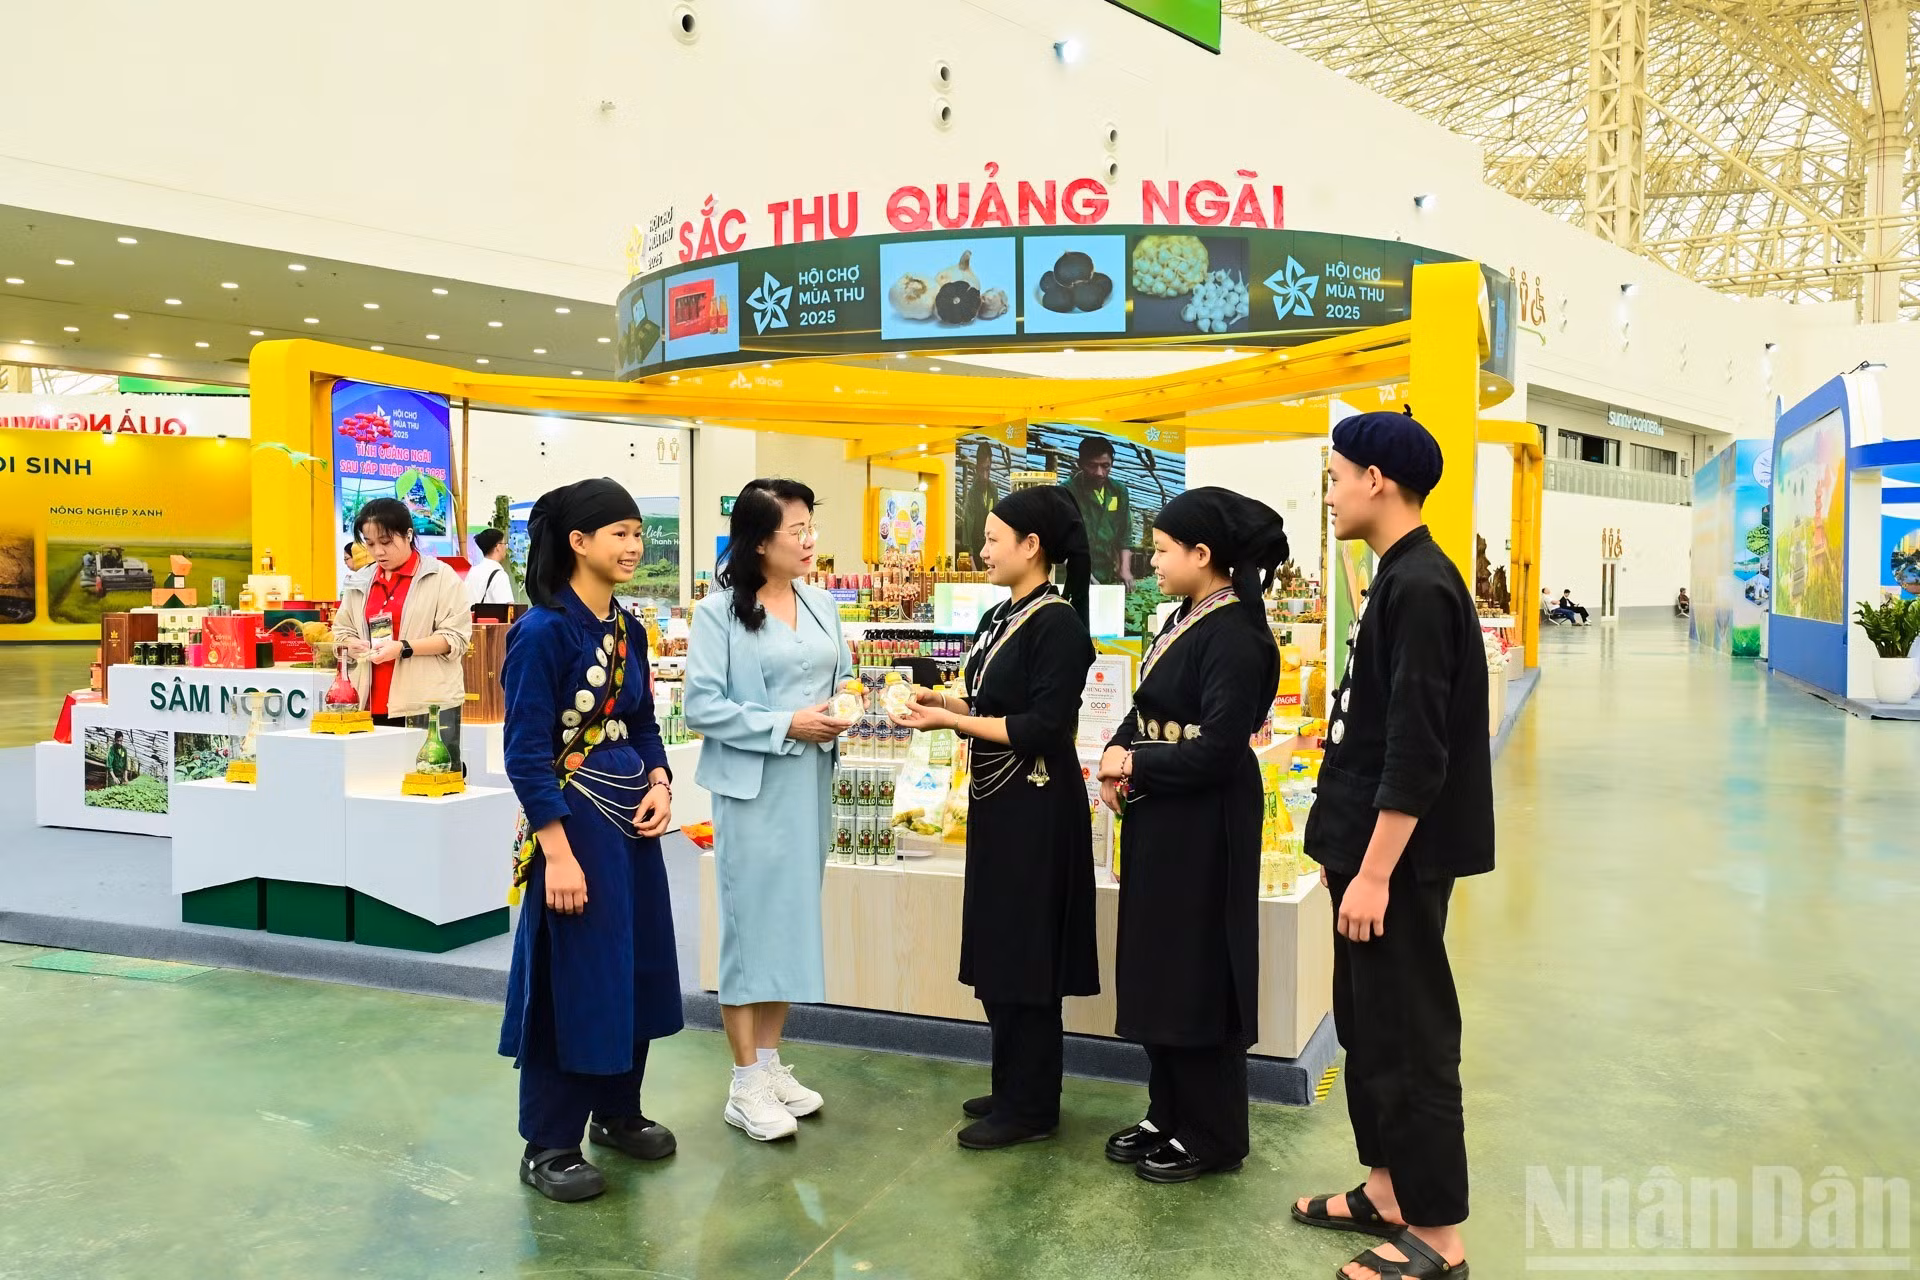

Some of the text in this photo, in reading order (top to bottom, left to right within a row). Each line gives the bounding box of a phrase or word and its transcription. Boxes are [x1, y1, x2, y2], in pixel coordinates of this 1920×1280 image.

[678, 162, 1284, 263] SẮC THU QUẢNG NGÃI
[798, 264, 860, 286] HỘI CHỢ
[1325, 260, 1382, 282] HỘI CHỢ
[798, 286, 865, 306] MÙA THU
[1325, 281, 1385, 302] MÙA THU
[799, 309, 836, 326] 2025
[1325, 304, 1361, 320] 2025
[393, 409, 404, 418] HỘI
[393, 430, 409, 439] 2025
[407, 422, 420, 430] THU
[410, 448, 432, 463] NGÃI
[26, 456, 92, 476] SINH
[340, 460, 358, 473] SAU
[379, 463, 403, 478] NHẬP
[50, 505, 163, 518] NÔNG NGHIỆP XANH
[150, 676, 210, 713] SÂM
[1091, 702, 1110, 710] OCOP
